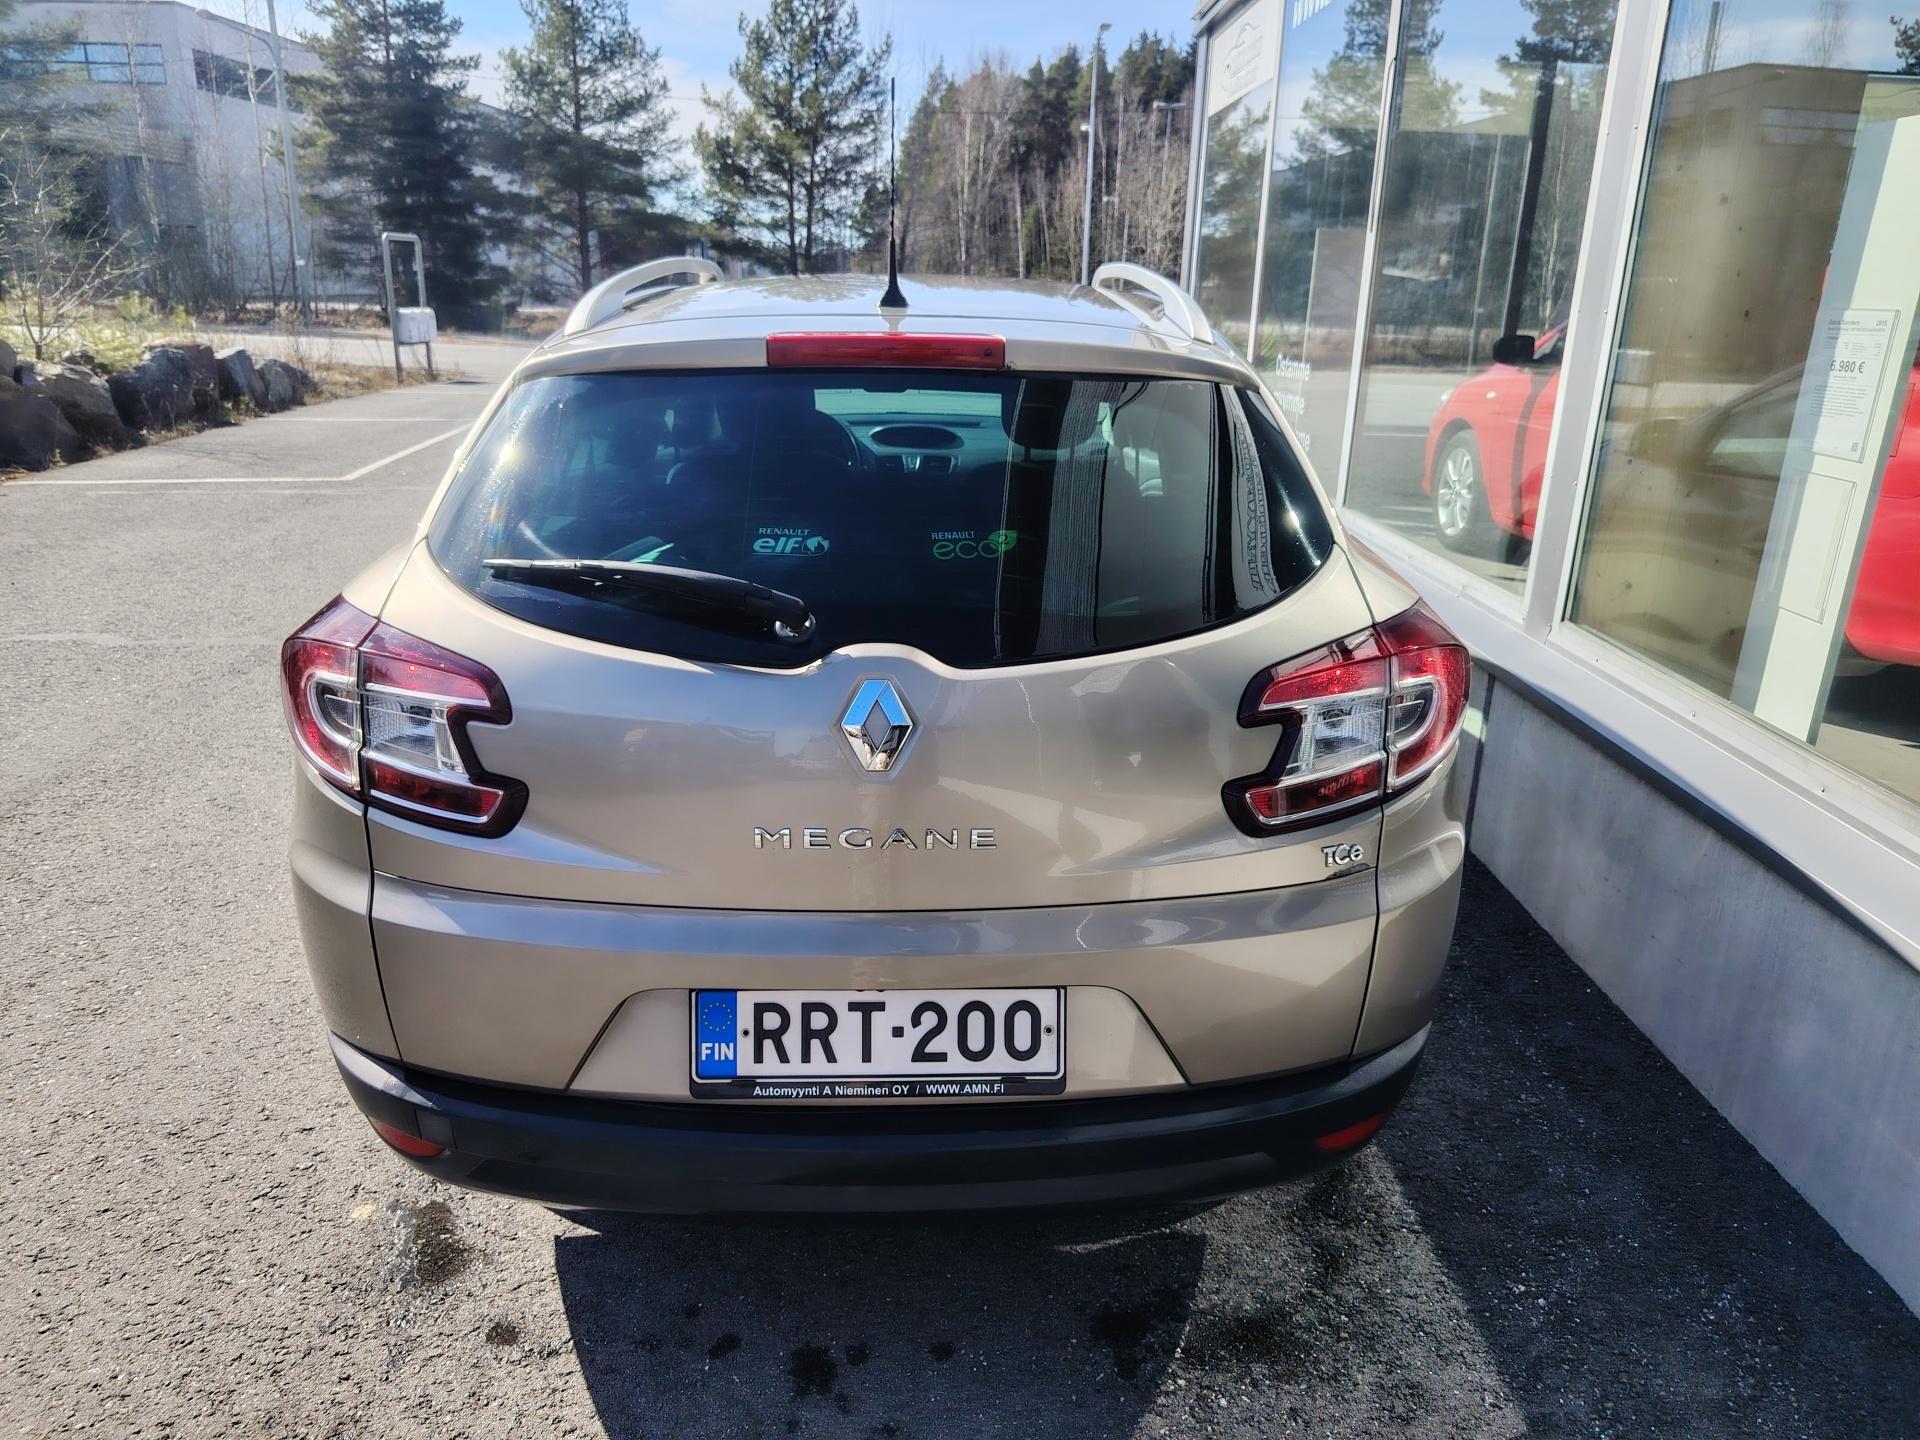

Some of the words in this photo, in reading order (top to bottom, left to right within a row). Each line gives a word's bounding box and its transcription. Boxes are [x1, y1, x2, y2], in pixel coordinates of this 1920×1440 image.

[1275, 353, 1311, 381] Ostamme
[1830, 359, 1856, 373] 6.980
[1858, 361, 1866, 374] €
[758, 527, 812, 536] RENAULT
[931, 530, 976, 540] RENAULT
[752, 536, 803, 554] elf
[753, 826, 998, 850] MEGANE
[753, 1000, 1042, 1064] RRT-200
[700, 1042, 734, 1061] FIN
[753, 1085, 820, 1097] Automyynti
[822, 1086, 832, 1096] A
[835, 1085, 889, 1096] Nieminen
[892, 1085, 909, 1095] OY
[925, 1083, 1004, 1095] WWW.AMN.FI
